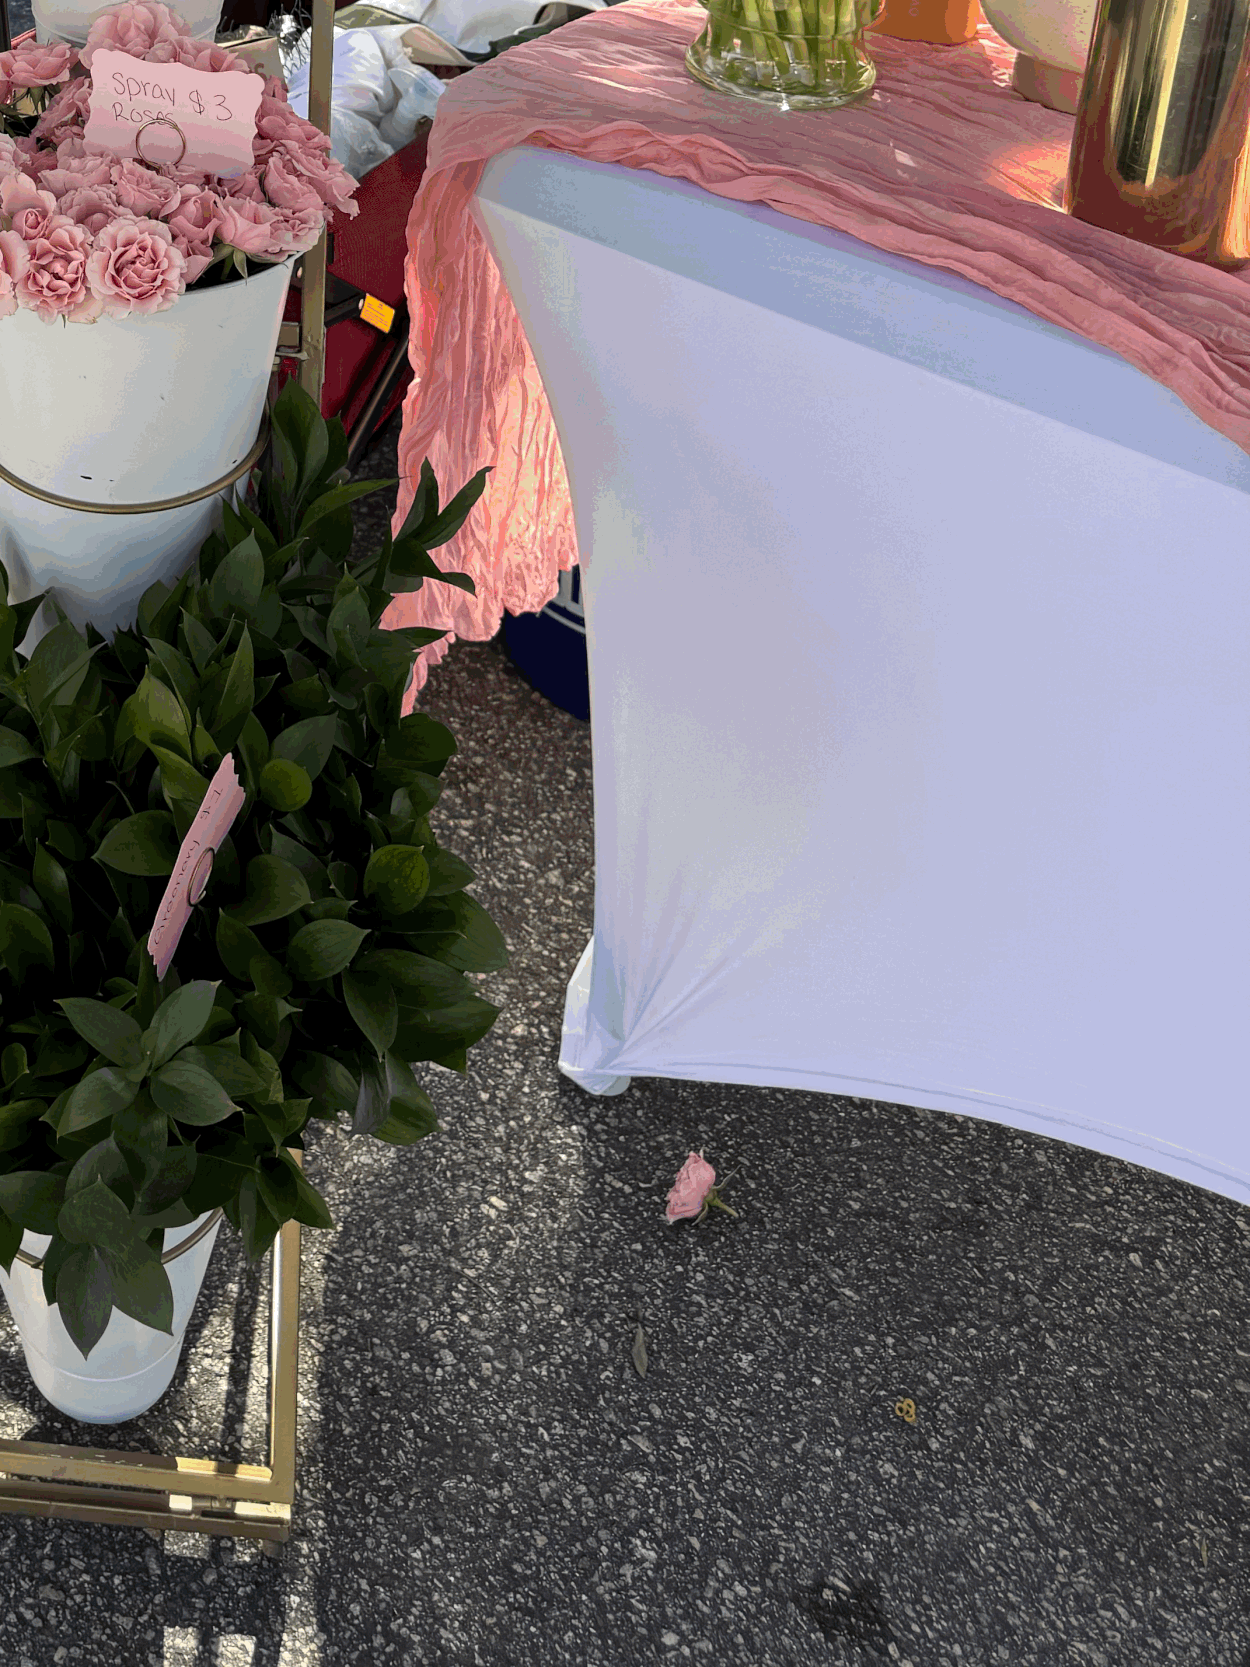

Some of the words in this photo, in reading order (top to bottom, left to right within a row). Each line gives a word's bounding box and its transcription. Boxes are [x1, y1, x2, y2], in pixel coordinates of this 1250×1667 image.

[111, 71, 176, 107] Spray
[188, 89, 233, 122] $3
[111, 101, 179, 129] Roses
[153, 839, 201, 946] Greenery
